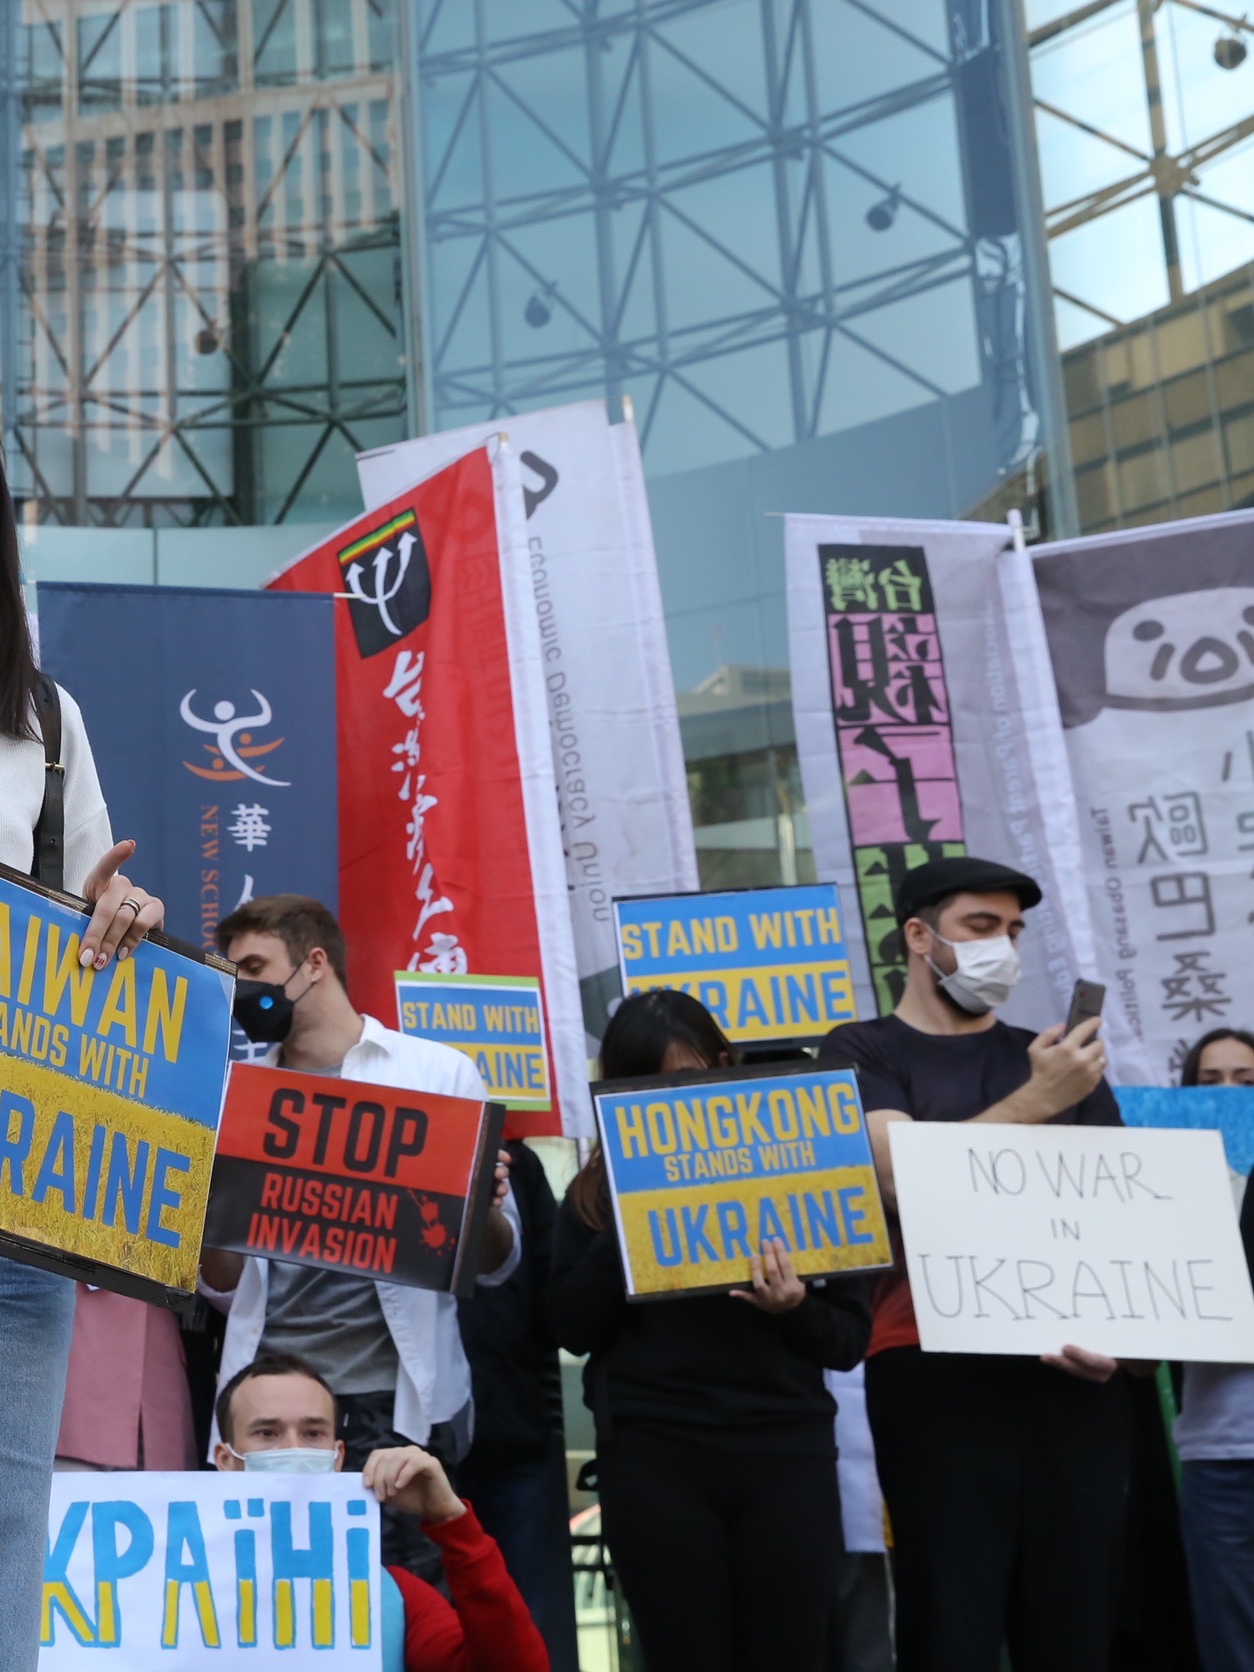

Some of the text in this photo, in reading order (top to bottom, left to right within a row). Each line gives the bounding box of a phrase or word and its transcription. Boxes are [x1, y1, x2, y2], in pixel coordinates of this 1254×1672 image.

[201, 805, 220, 861] NEW
[623, 907, 842, 961] STAND WITH
[403, 1002, 540, 1034] STAND WITH
[78, 1033, 149, 1099] WITH
[475, 1051, 544, 1090] AINE
[262, 1088, 428, 1178] STOP
[614, 1083, 861, 1160] HONGKONG
[664, 1140, 816, 1183] STANDS WITH
[968, 1148, 1174, 1203] NO WAR
[260, 1172, 399, 1231] RUSSIAN
[648, 1186, 874, 1269] UKRAINE
[1050, 1218, 1082, 1241] IN
[246, 1212, 398, 1275] INVASION
[917, 1253, 1234, 1322] UKRAINE
